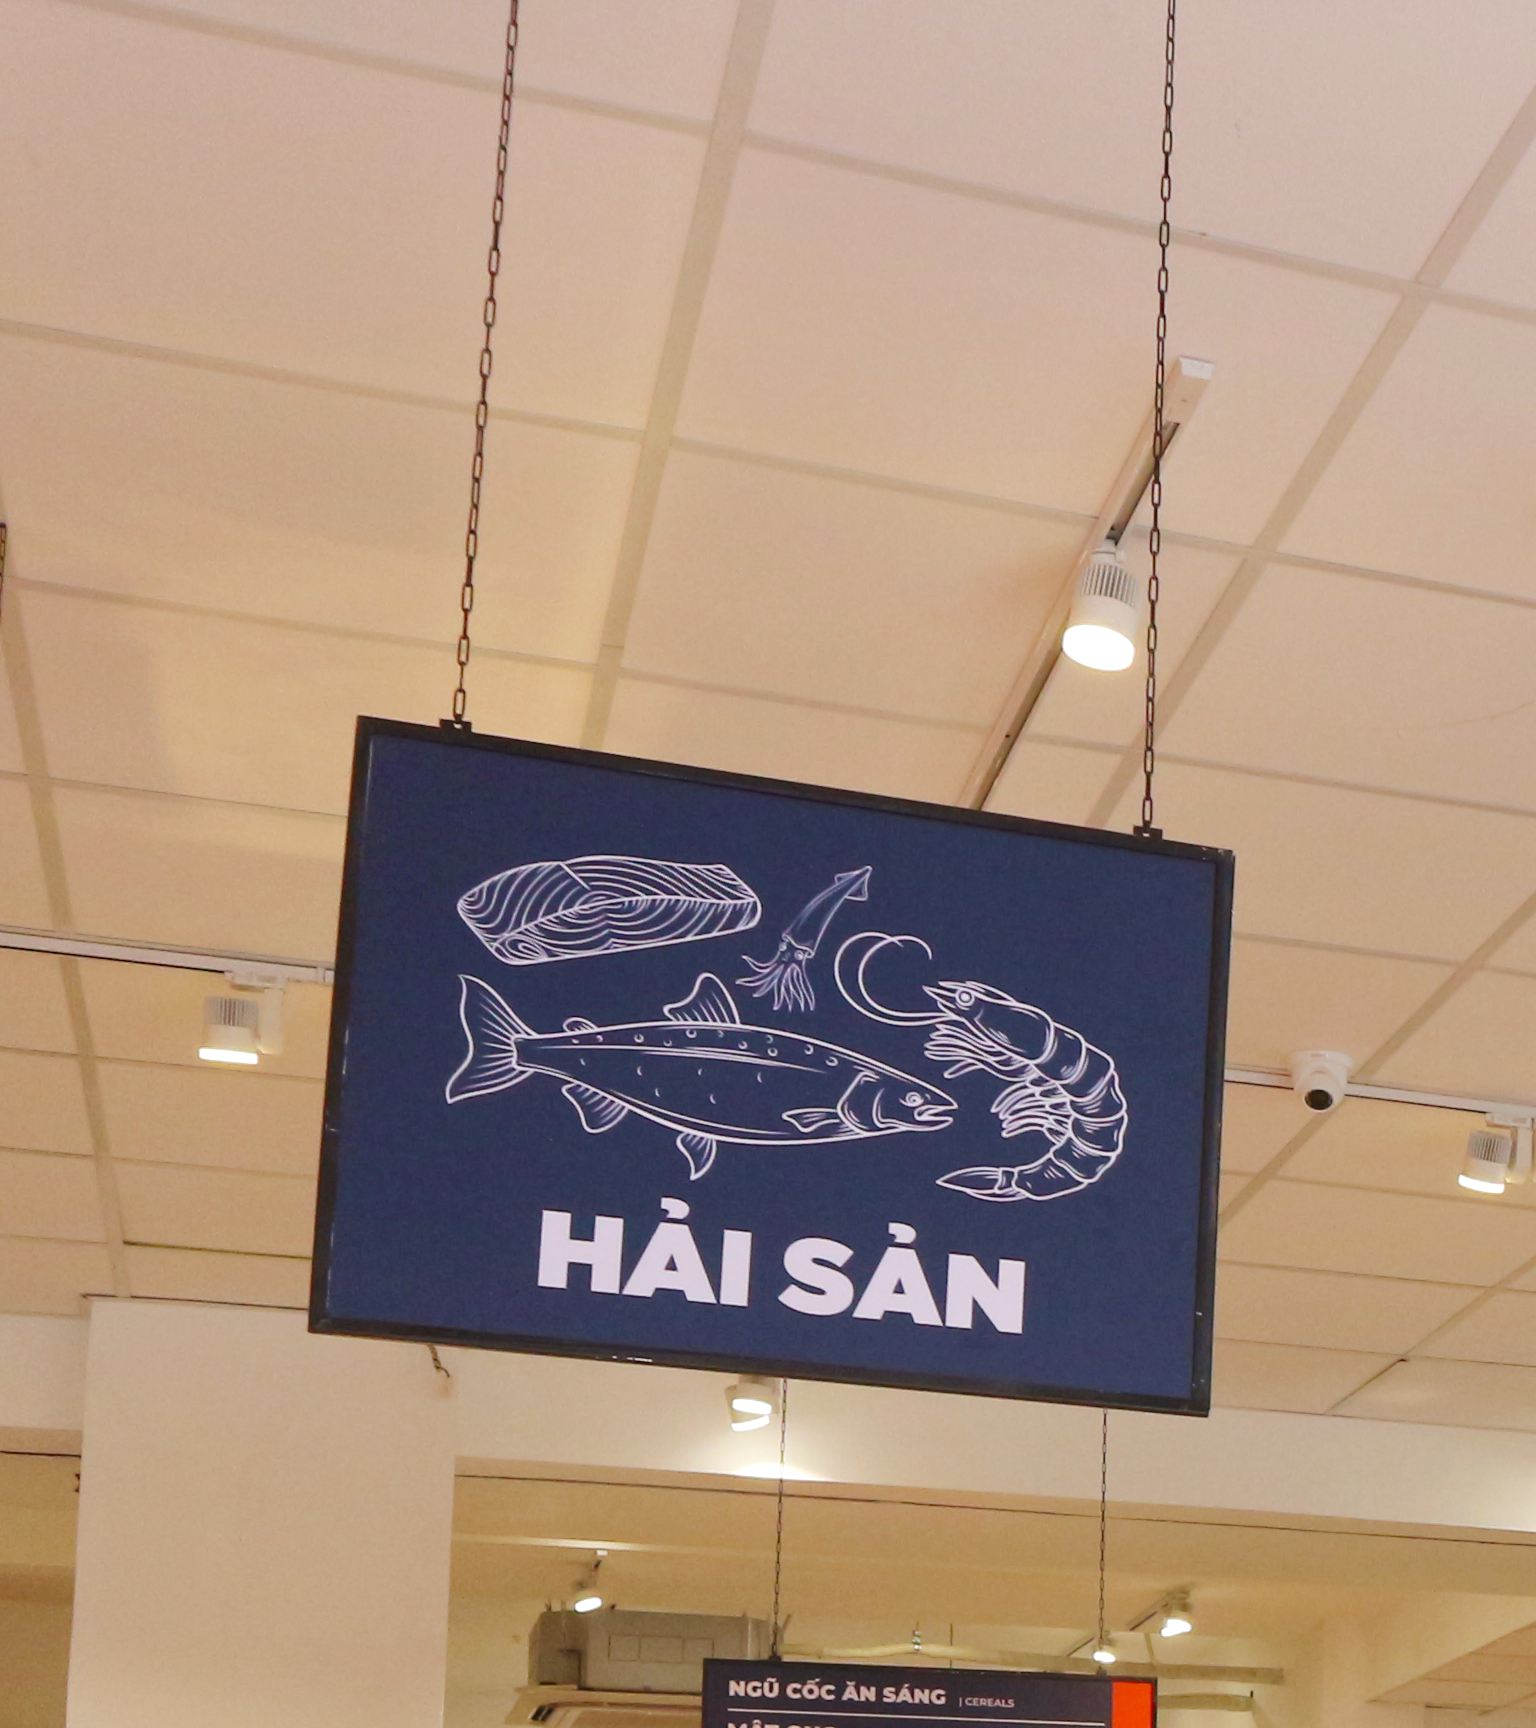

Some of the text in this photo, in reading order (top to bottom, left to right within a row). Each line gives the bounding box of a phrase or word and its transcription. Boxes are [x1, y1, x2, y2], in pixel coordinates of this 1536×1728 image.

[538, 1197, 1025, 1334] HẢI SẢN
[729, 1676, 1015, 1708] NGŨ CỐC ĂN SÁNG CEREALS
